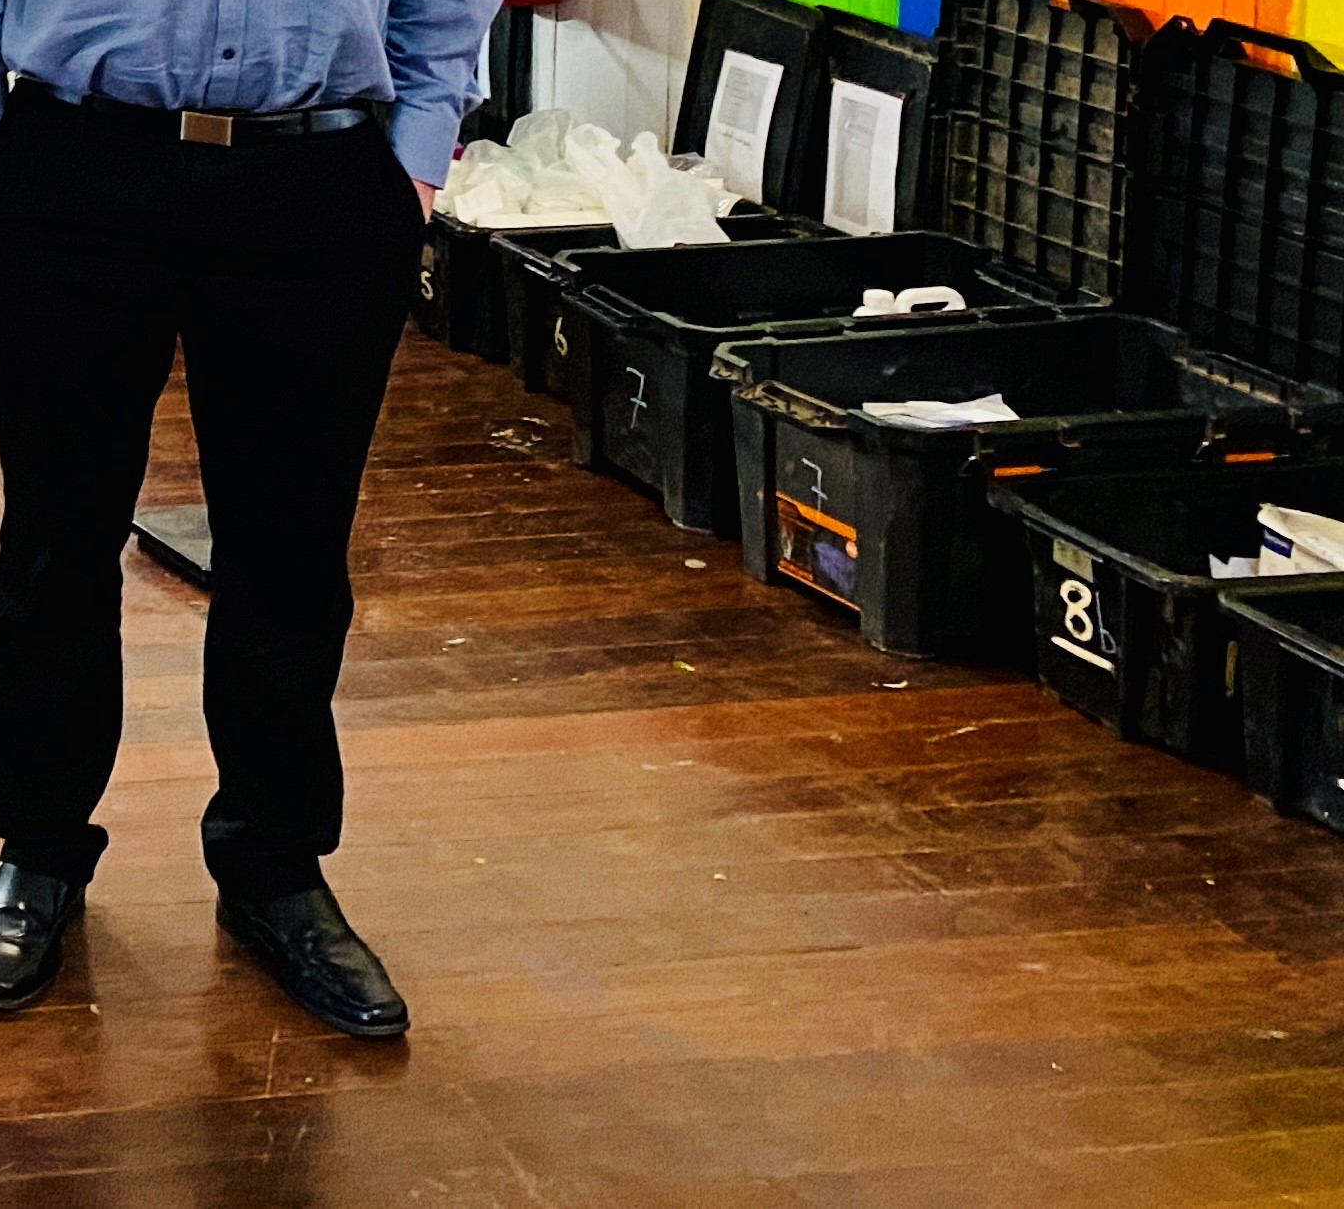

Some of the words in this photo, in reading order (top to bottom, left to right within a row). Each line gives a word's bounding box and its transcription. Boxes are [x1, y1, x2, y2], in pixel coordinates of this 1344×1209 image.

[420, 270, 434, 301] 5
[554, 316, 568, 356] 6
[626, 366, 648, 430] 7
[800, 456, 829, 512] 7
